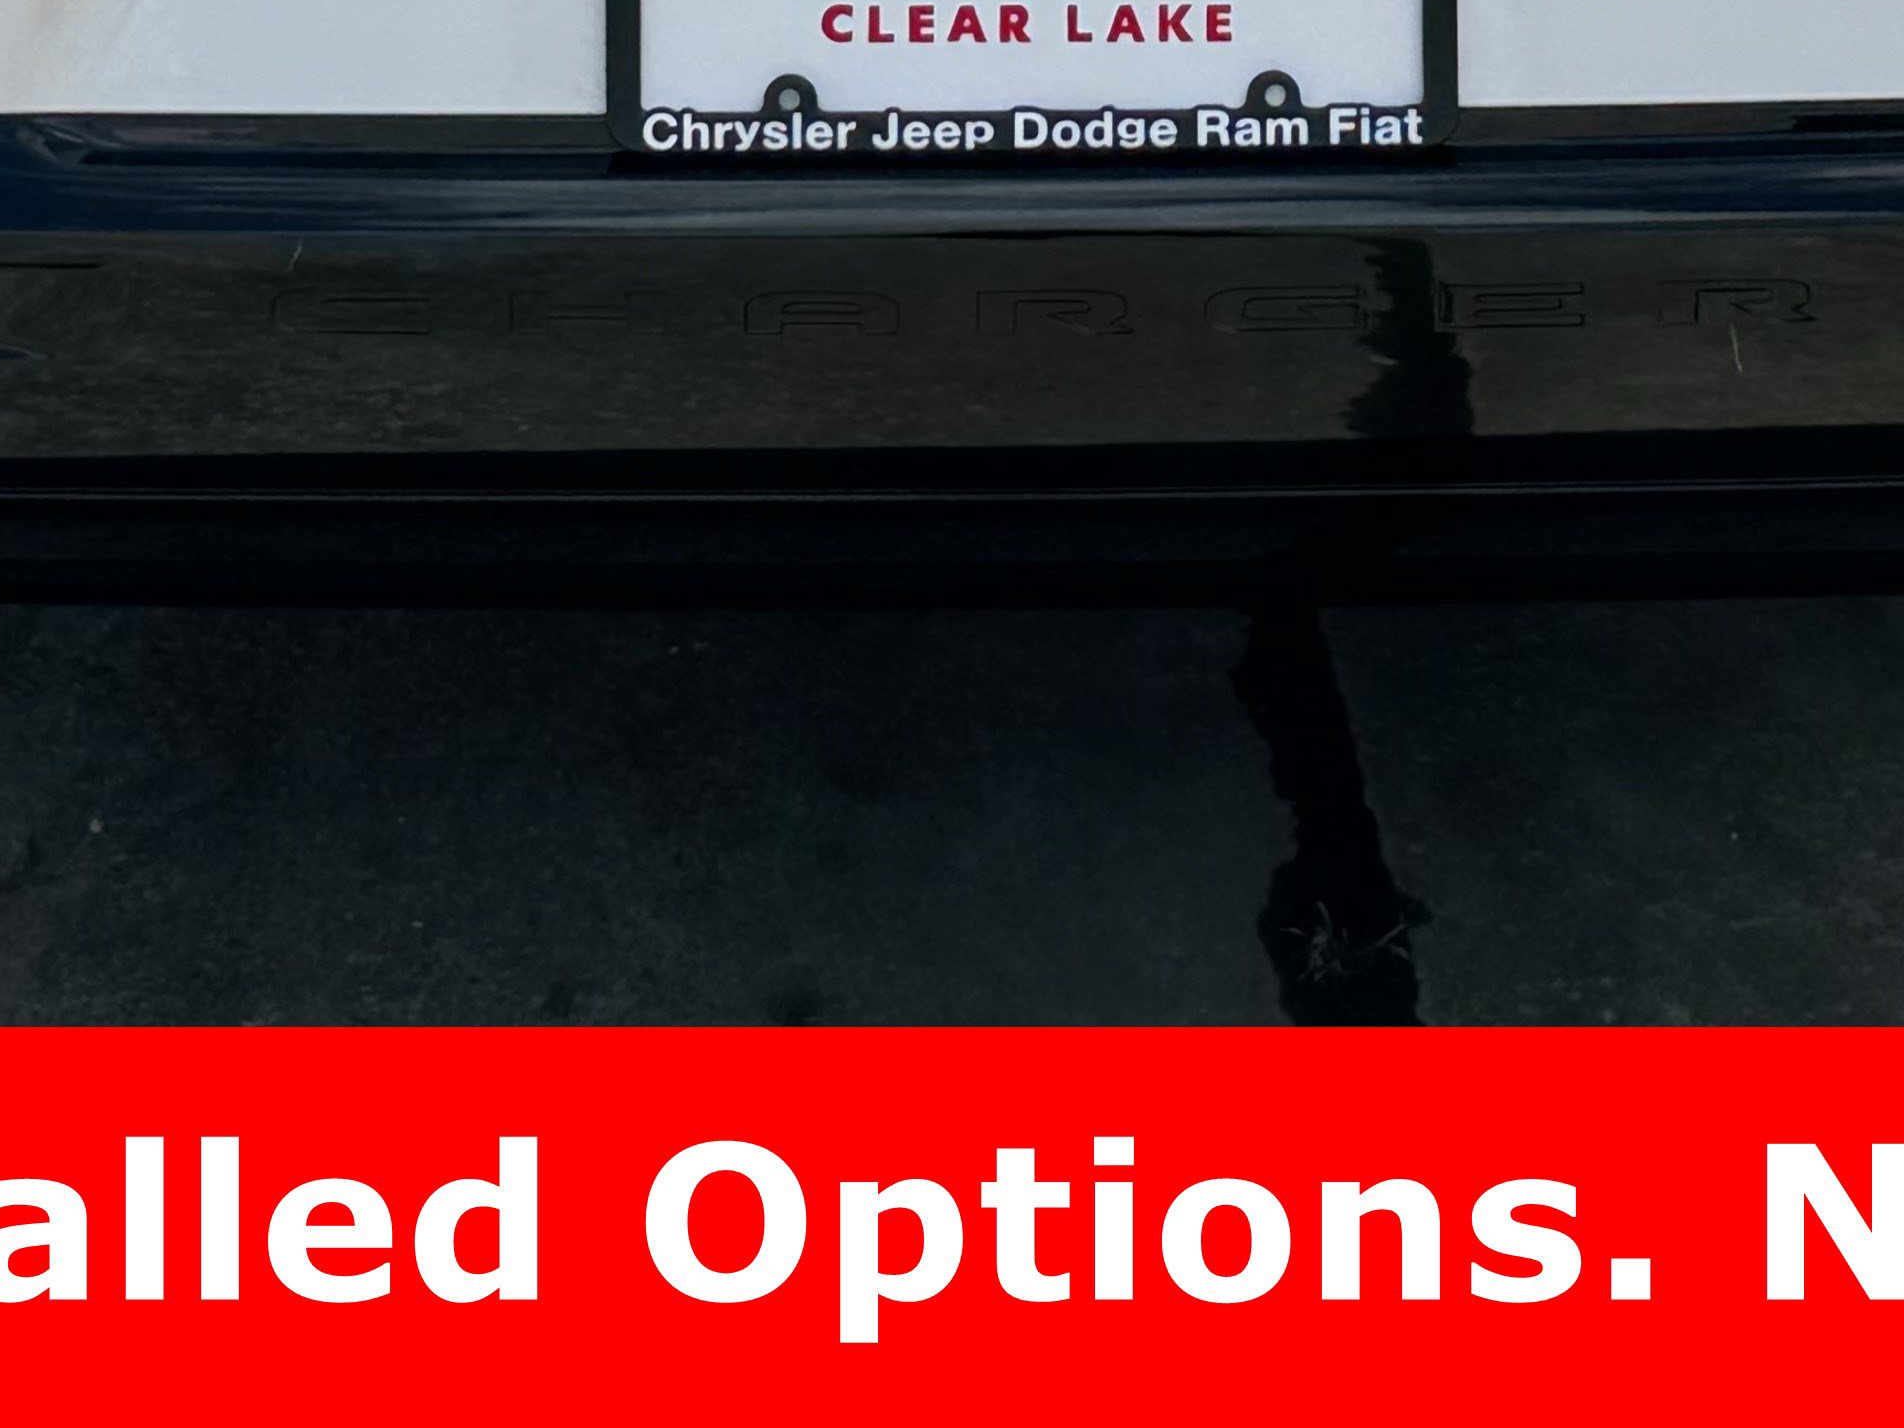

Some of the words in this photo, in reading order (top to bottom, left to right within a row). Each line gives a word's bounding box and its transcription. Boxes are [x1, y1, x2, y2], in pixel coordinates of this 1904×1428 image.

[821, 4, 1030, 44] CLEAR
[1067, 4, 1233, 43] LAKE
[641, 110, 857, 152] Chrysler
[871, 112, 996, 151] Jeep
[1013, 111, 1178, 148] Dodge
[1195, 110, 1309, 147] Ram
[1328, 106, 1424, 146] Fiat
[268, 276, 1816, 337] CHARGER
